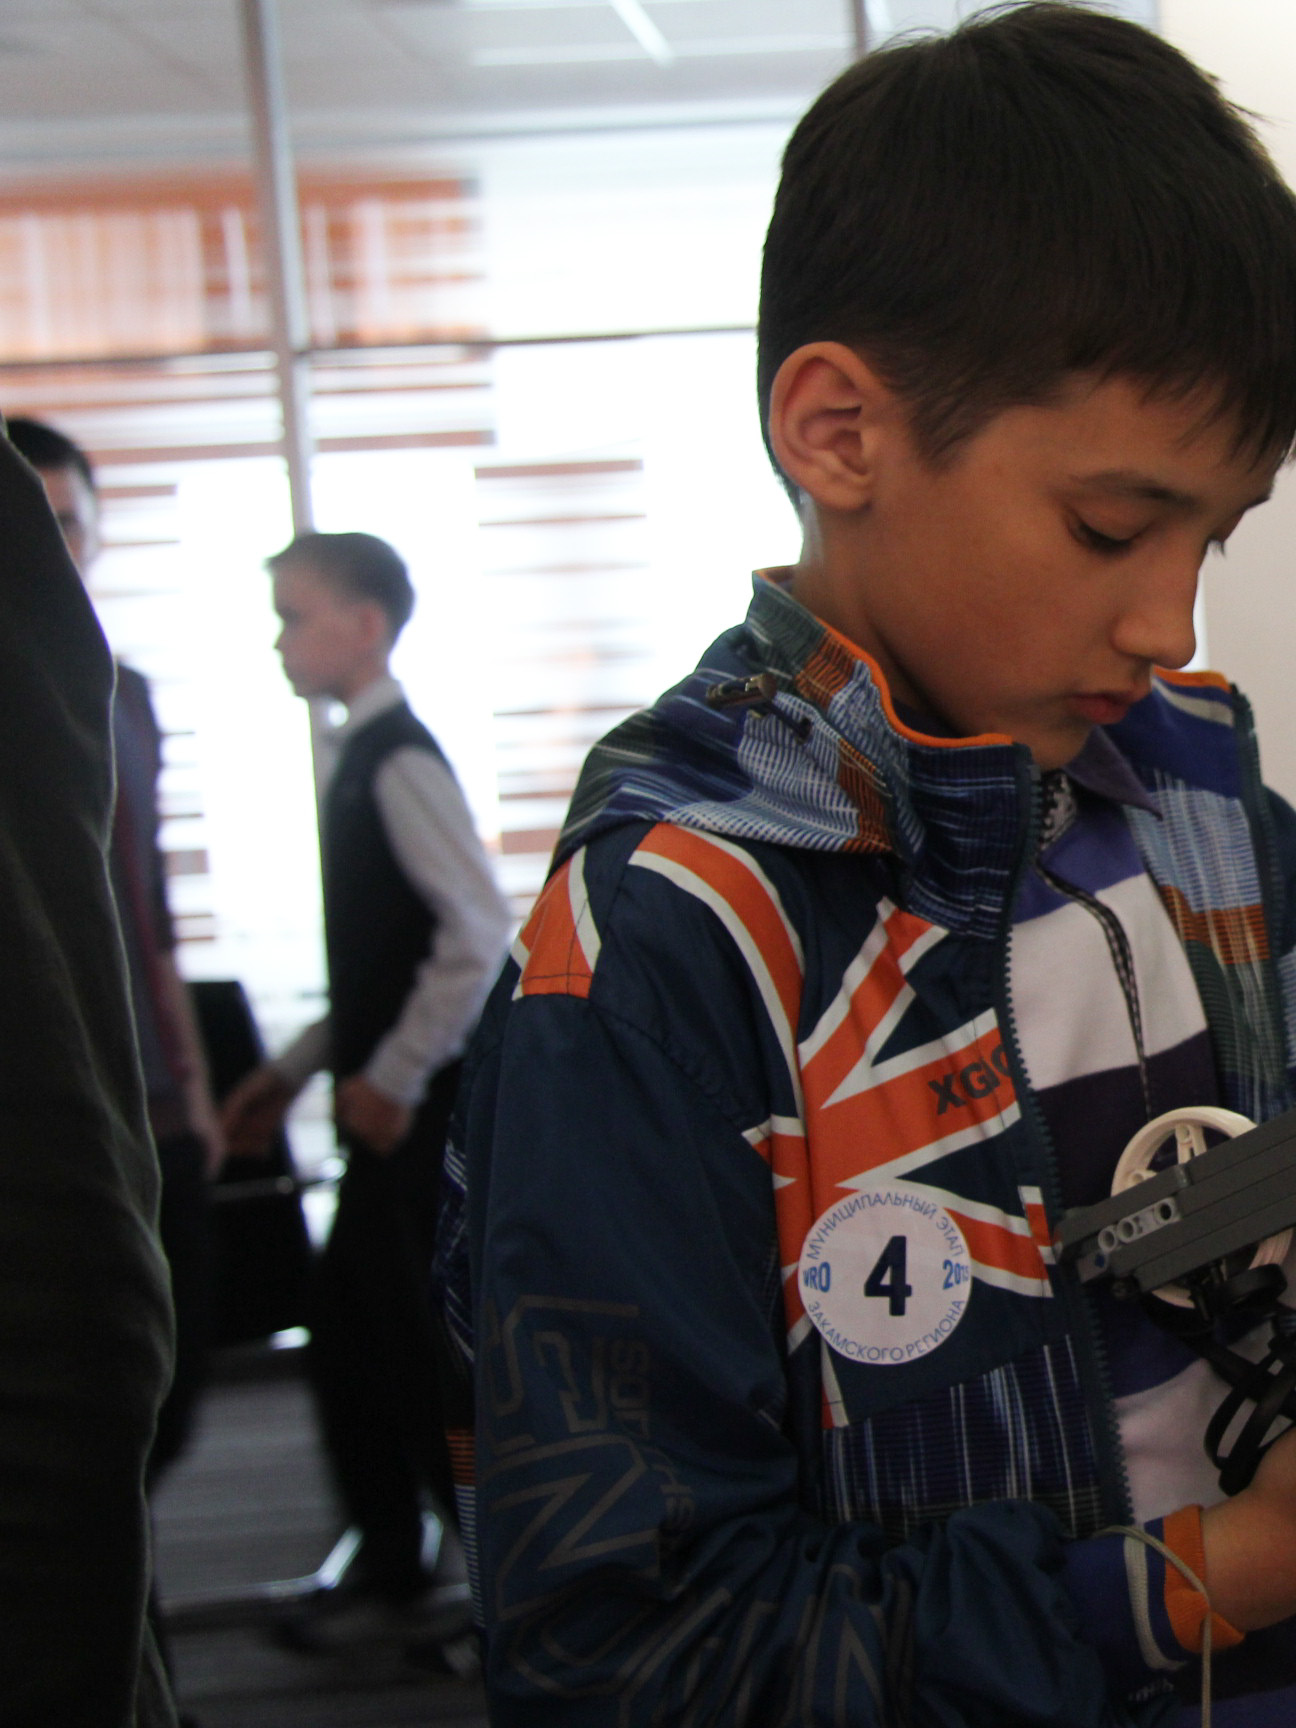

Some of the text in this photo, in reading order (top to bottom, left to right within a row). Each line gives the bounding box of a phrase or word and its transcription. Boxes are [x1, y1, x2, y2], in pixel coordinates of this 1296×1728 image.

[806, 1191, 964, 1260] МУНИЦИПАЛЬНЫЙ ЭТАП
[864, 1235, 913, 1317] 4
[808, 1299, 965, 1362] ЗАКАМСКОГО РЕГИОНА
